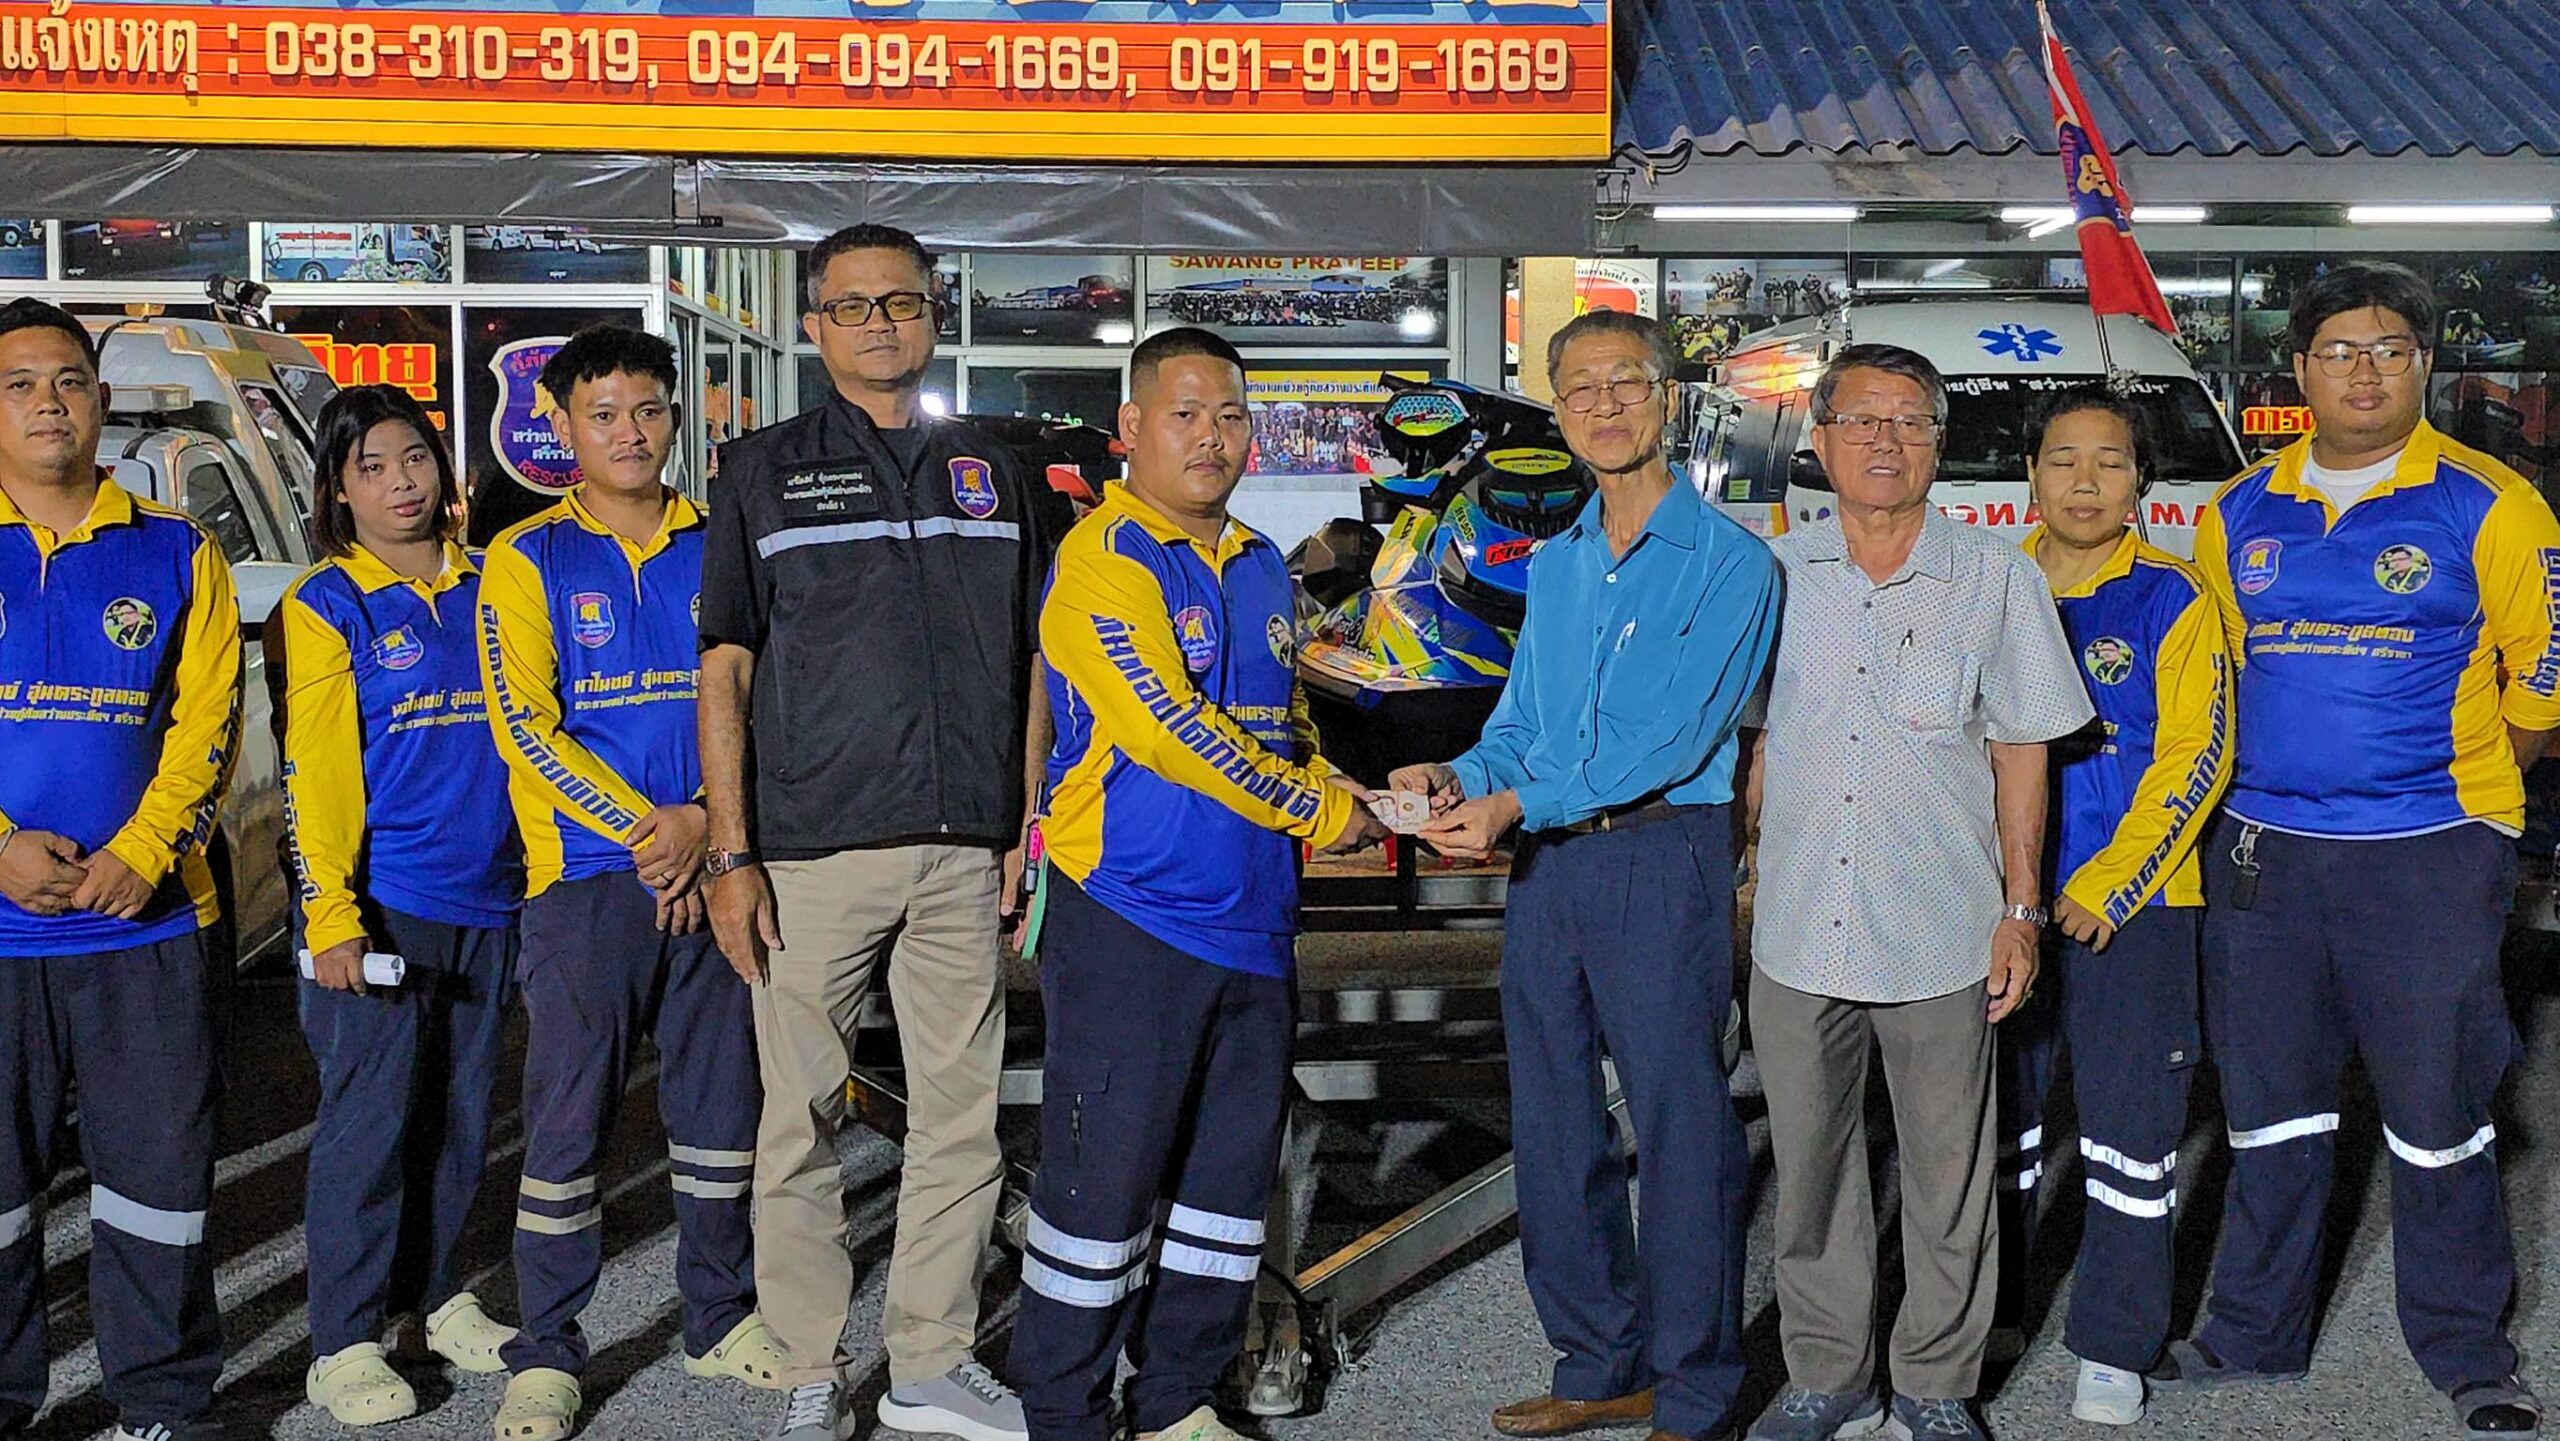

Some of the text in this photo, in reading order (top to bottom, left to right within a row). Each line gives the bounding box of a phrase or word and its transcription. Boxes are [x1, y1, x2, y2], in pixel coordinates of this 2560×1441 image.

[3, 0, 198, 92] แจ้งเหตุ
[266, 22, 659, 88] 038-310-319,
[688, 30, 1137, 98] 094-094-1669,
[1171, 38, 1567, 92] 091-919-1669
[1169, 255, 1409, 271] SAWANG PRATEEP
